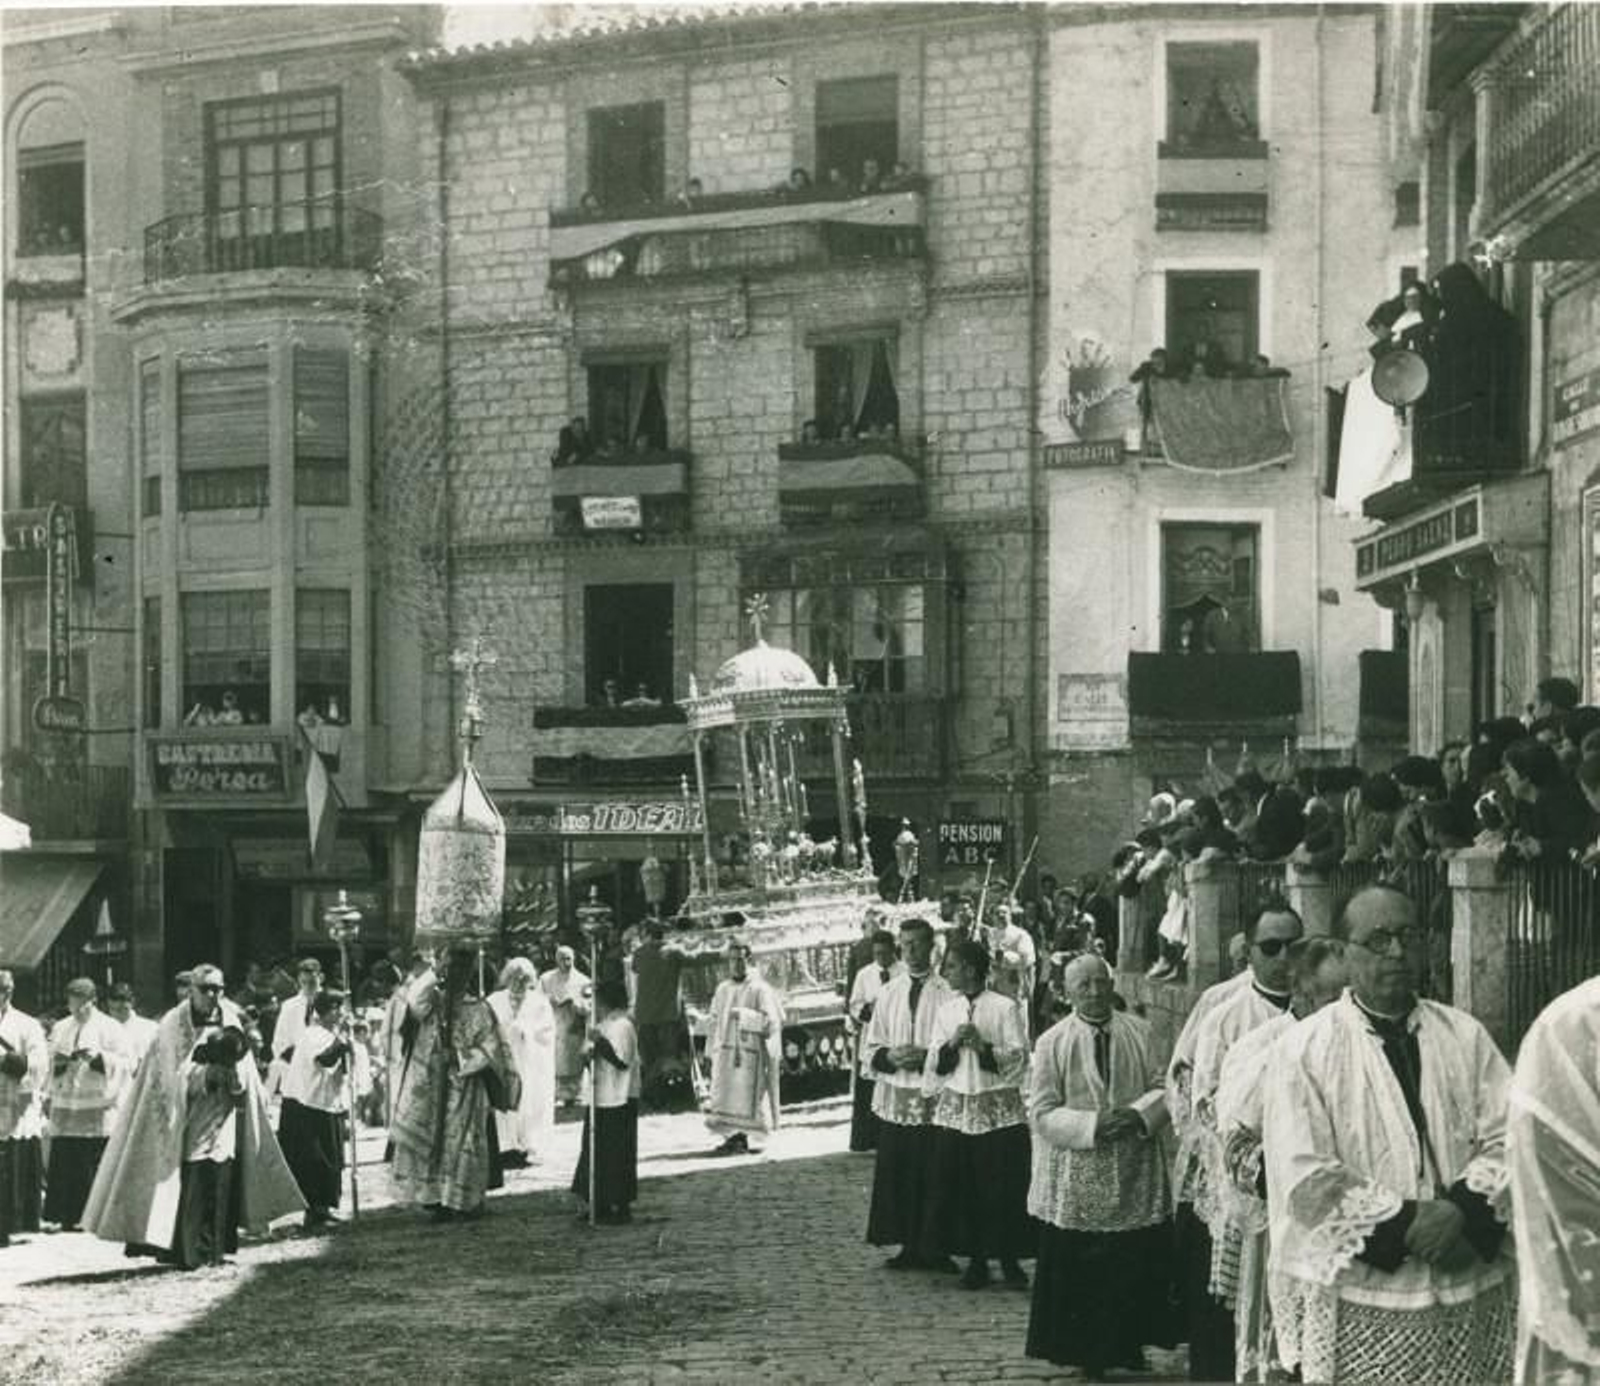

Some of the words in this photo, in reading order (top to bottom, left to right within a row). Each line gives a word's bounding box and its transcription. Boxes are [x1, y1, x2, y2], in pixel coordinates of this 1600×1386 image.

[593, 803, 703, 832] IDEAL
[939, 823, 1003, 843] PENSION
[944, 846, 998, 865] ABC
